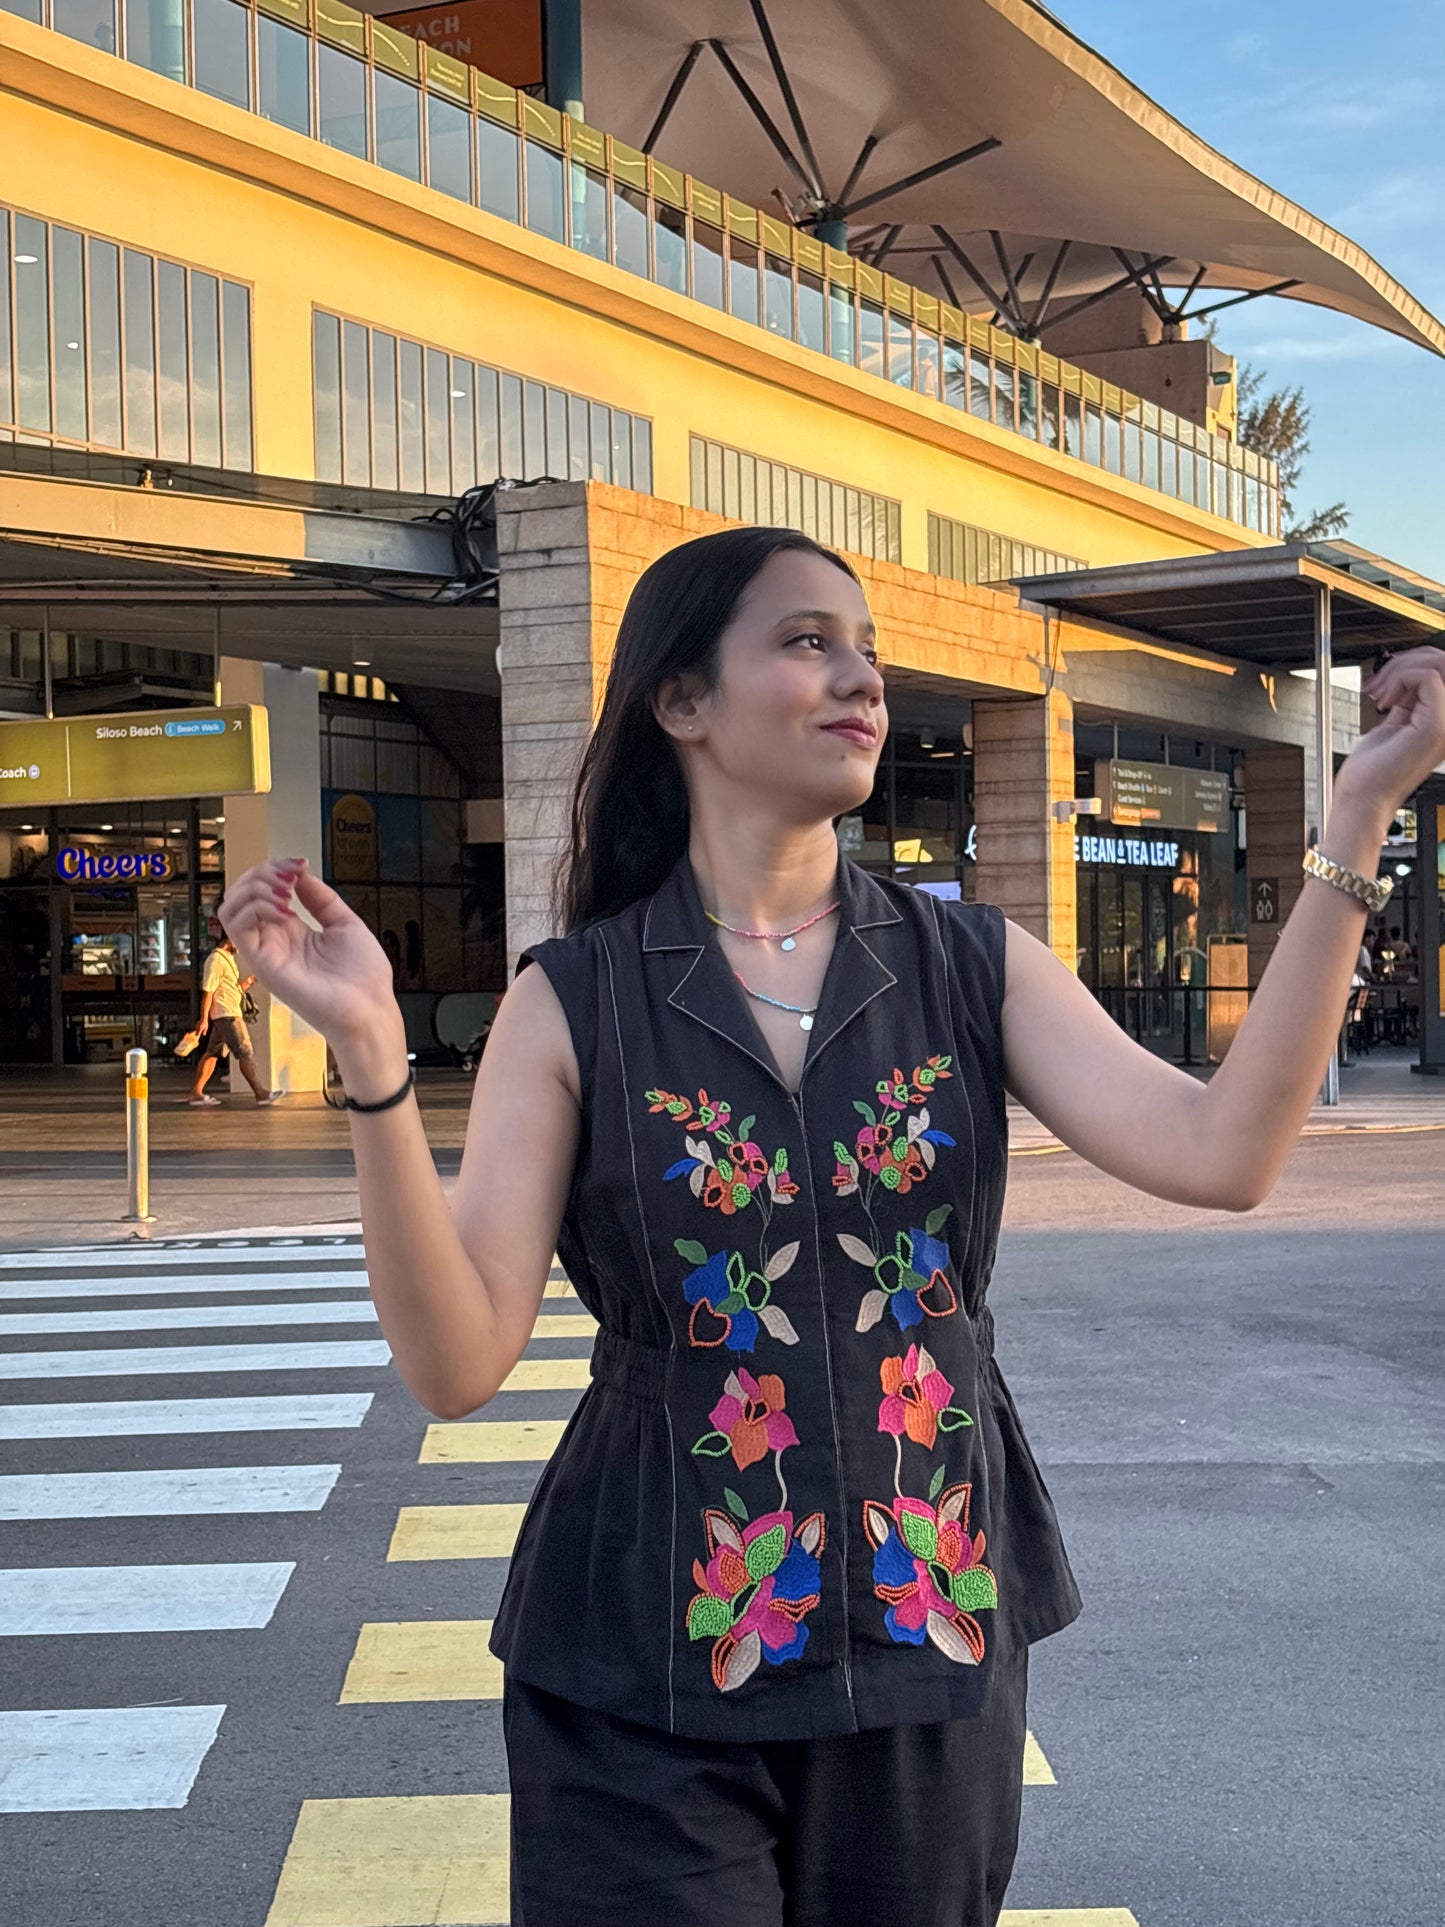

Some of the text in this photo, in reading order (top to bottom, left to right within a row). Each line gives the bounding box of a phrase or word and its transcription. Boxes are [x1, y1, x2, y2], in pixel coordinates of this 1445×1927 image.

[96, 724, 163, 739] Siloso Beach
[177, 723, 220, 733] Beach Walk
[1082, 835, 1116, 864] BEAN
[1116, 838, 1126, 865] &
[1125, 839, 1149, 866] TEA
[1149, 841, 1179, 868] LEAF
[57, 848, 171, 881] Cheers
